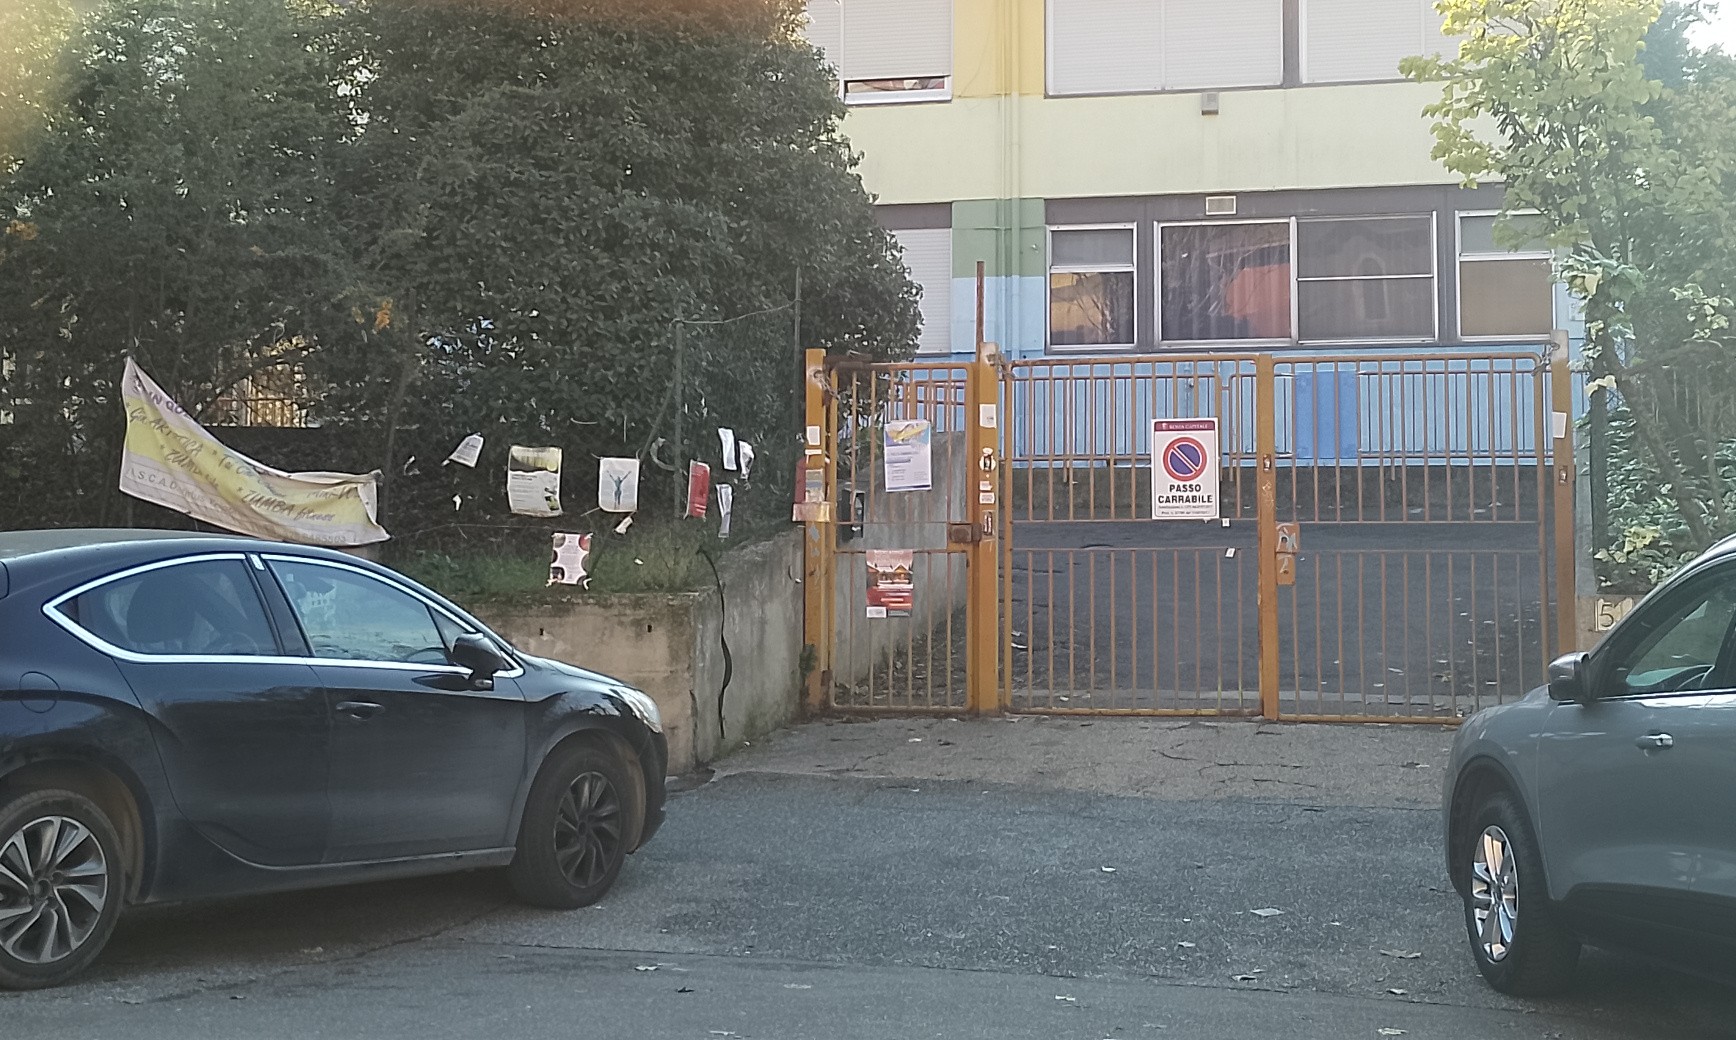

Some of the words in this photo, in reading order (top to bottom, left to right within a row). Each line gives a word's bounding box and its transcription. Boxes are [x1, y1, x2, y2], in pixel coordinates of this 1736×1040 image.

[1169, 484, 1202, 493] PASSO
[242, 489, 296, 515] ZUMBA
[1158, 495, 1213, 504] CARRABILE
